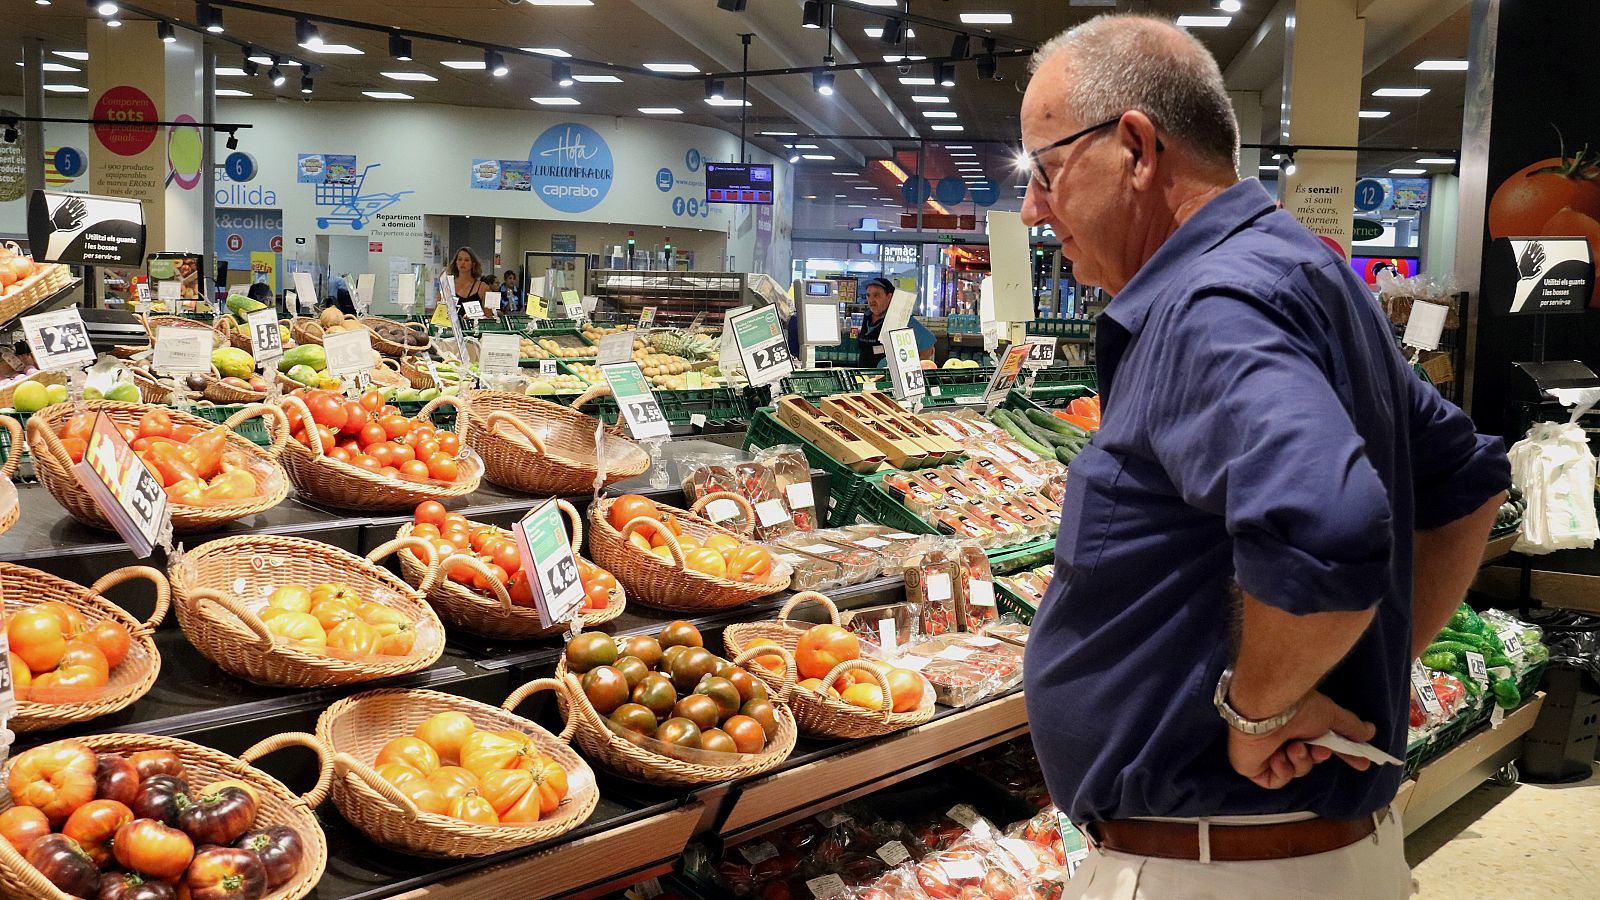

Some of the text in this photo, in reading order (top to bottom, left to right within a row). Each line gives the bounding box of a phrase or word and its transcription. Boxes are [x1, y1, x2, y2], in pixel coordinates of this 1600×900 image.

[102, 97, 149, 107] Comparent
[107, 107, 144, 121] tots
[540, 127, 598, 166] Hola
[65, 154, 71, 170] 5
[122, 163, 154, 172] productes
[236, 159, 243, 175] 6
[542, 184, 599, 198] caprabo
[1295, 183, 1306, 194] És
[1304, 196, 1313, 204] si
[1362, 186, 1375, 205] 12
[1297, 206, 1314, 214] més
[376, 213, 421, 221] Repartiment
[85, 233, 137, 245] Utilitzi els guants
[97, 244, 118, 252] bosses
[83, 252, 121, 261] per servir-se
[1543, 278, 1561, 286] Utilitzi
[1568, 278, 1586, 287] guants
[1552, 288, 1569, 296] bosses
[1540, 299, 1571, 308] per servir-se
[45, 326, 86, 352] 2,95
[895, 332, 912, 347] BIO
[1031, 344, 1053, 359] 4,15
[757, 349, 787, 368] 2,85
[632, 403, 660, 422] 2,55
[553, 564, 576, 590] 4,49
